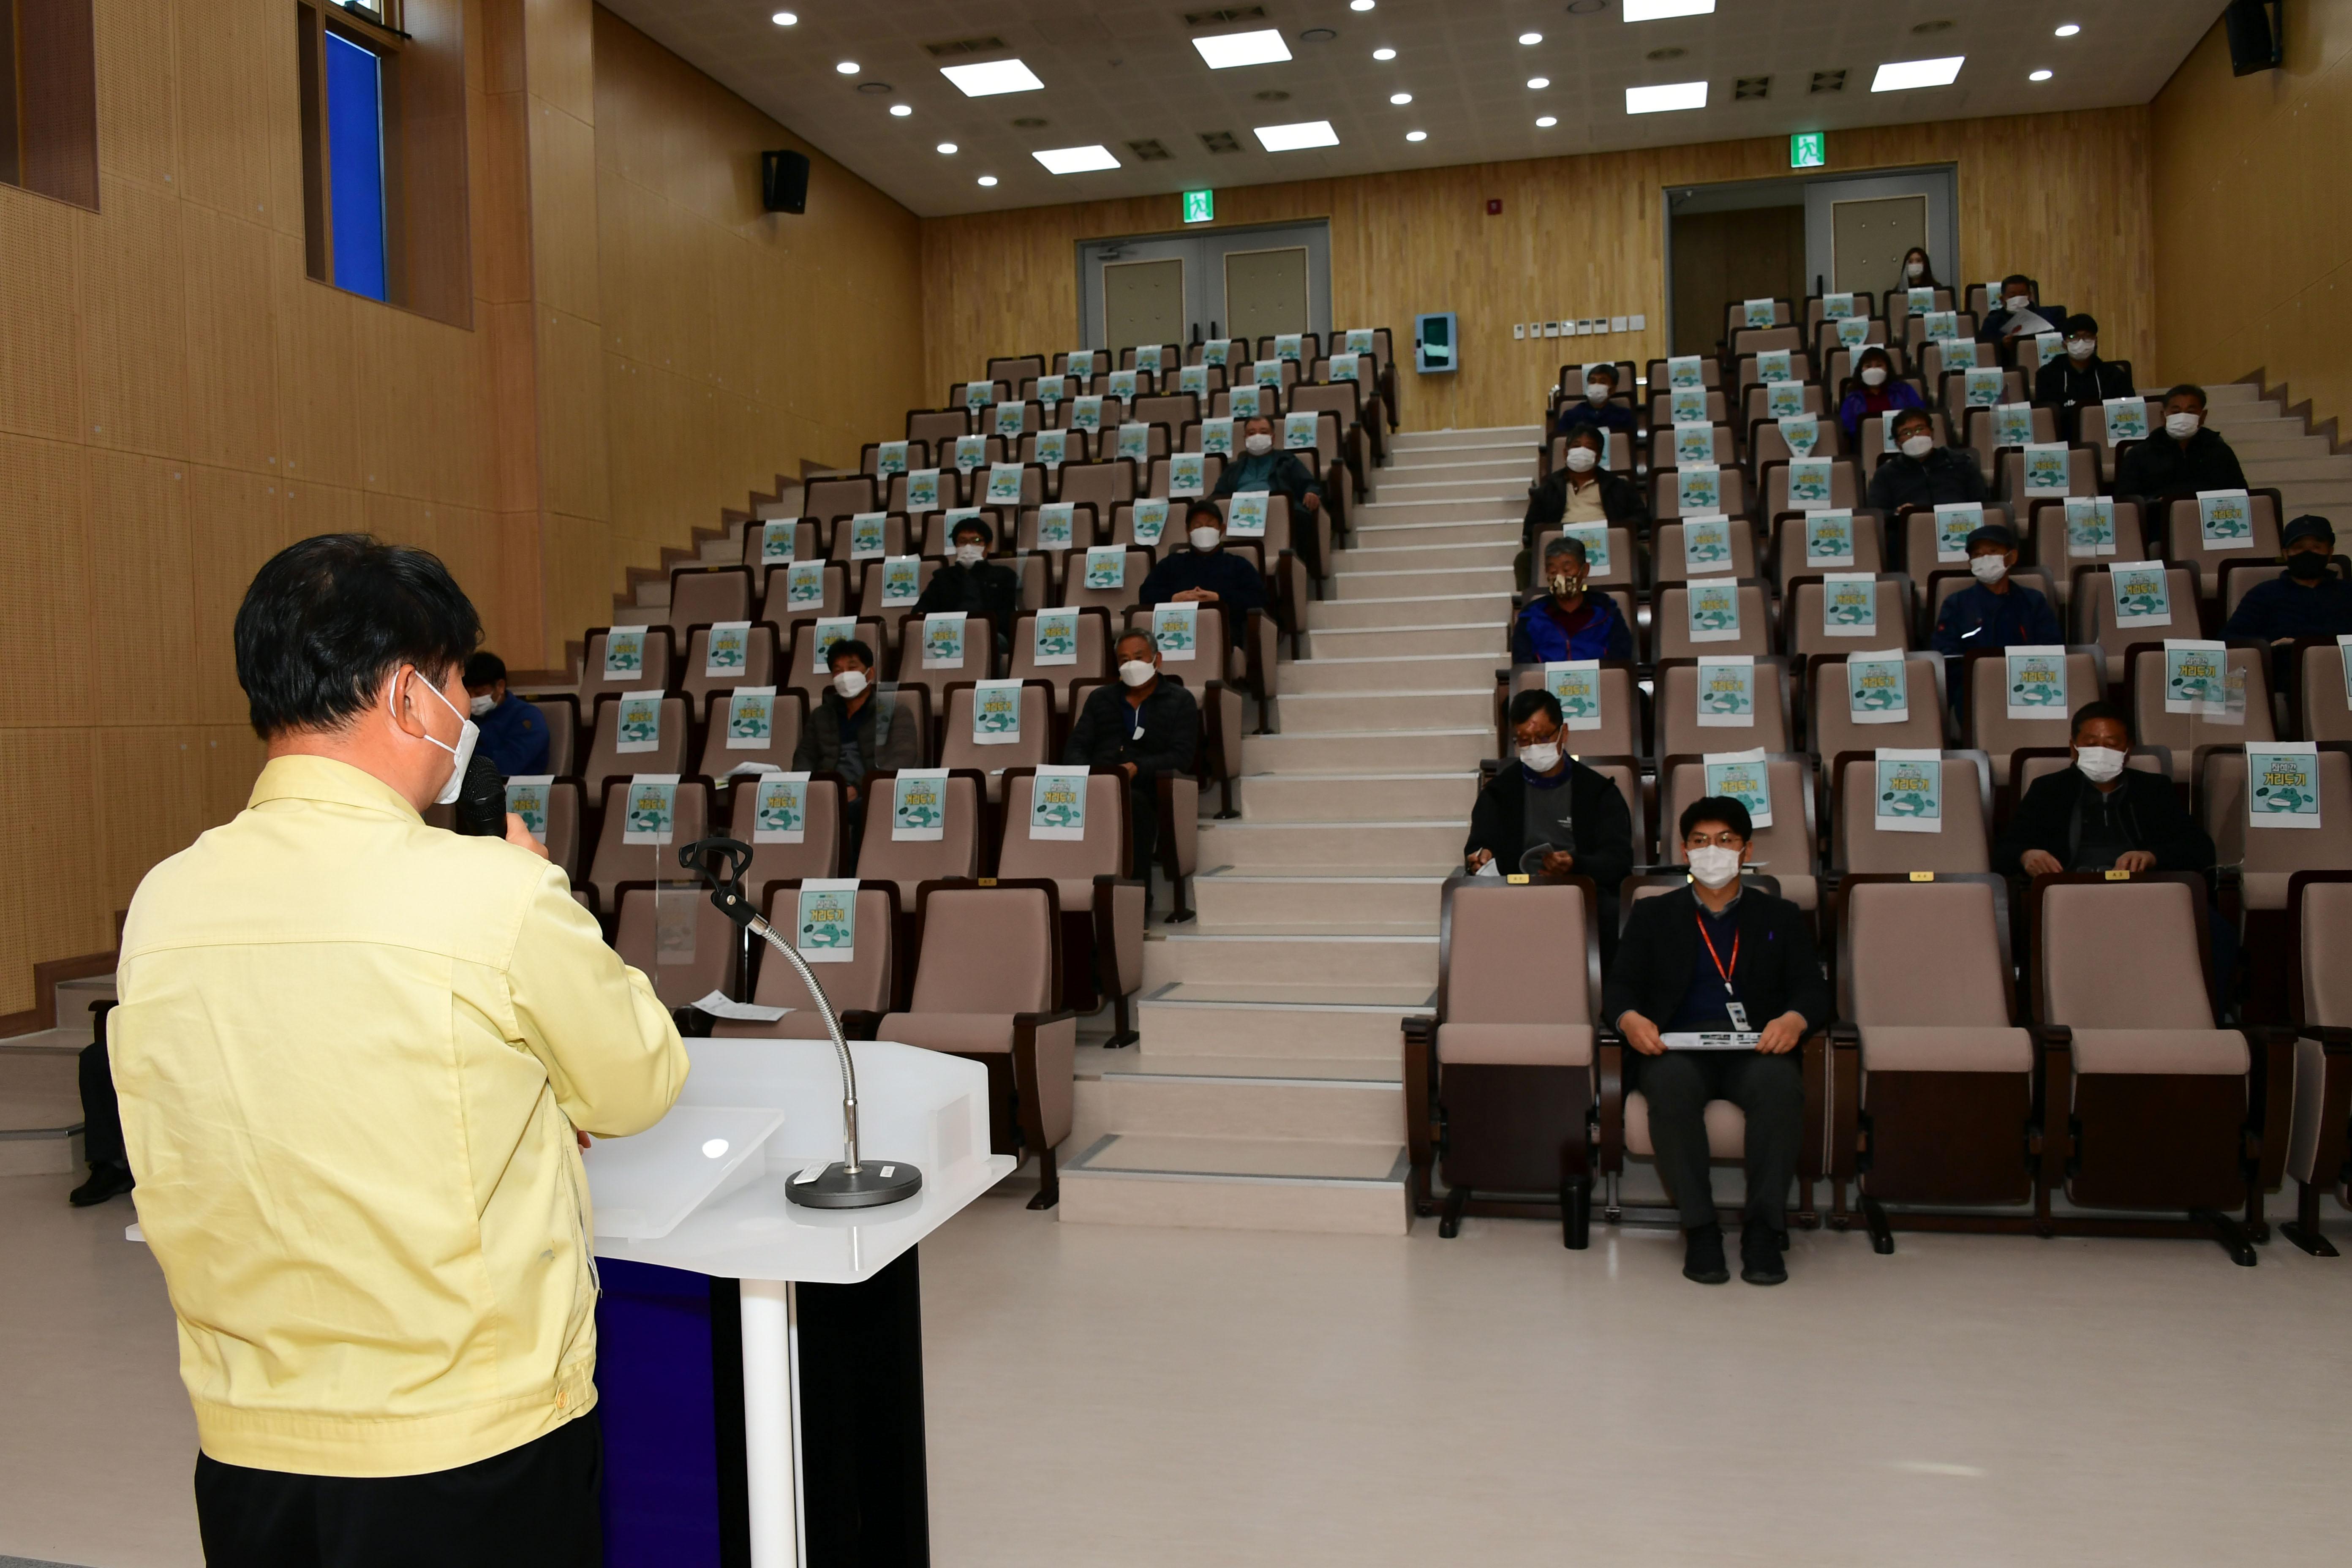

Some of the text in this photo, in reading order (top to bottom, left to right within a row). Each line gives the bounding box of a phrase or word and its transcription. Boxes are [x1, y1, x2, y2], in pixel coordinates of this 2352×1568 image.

[2020, 672, 2055, 682] 거리두기
[2179, 666, 2215, 677] 거리두기
[1861, 676, 1895, 688] 거리두기
[2272, 763, 2297, 772] 좌석 간
[2264, 773, 2306, 785] 거리두기
[1890, 779, 1929, 791] 거리두기
[905, 794, 936, 805] 거리두기
[1043, 793, 1076, 803] 거리두기
[810, 909, 844, 922] 거리두기
